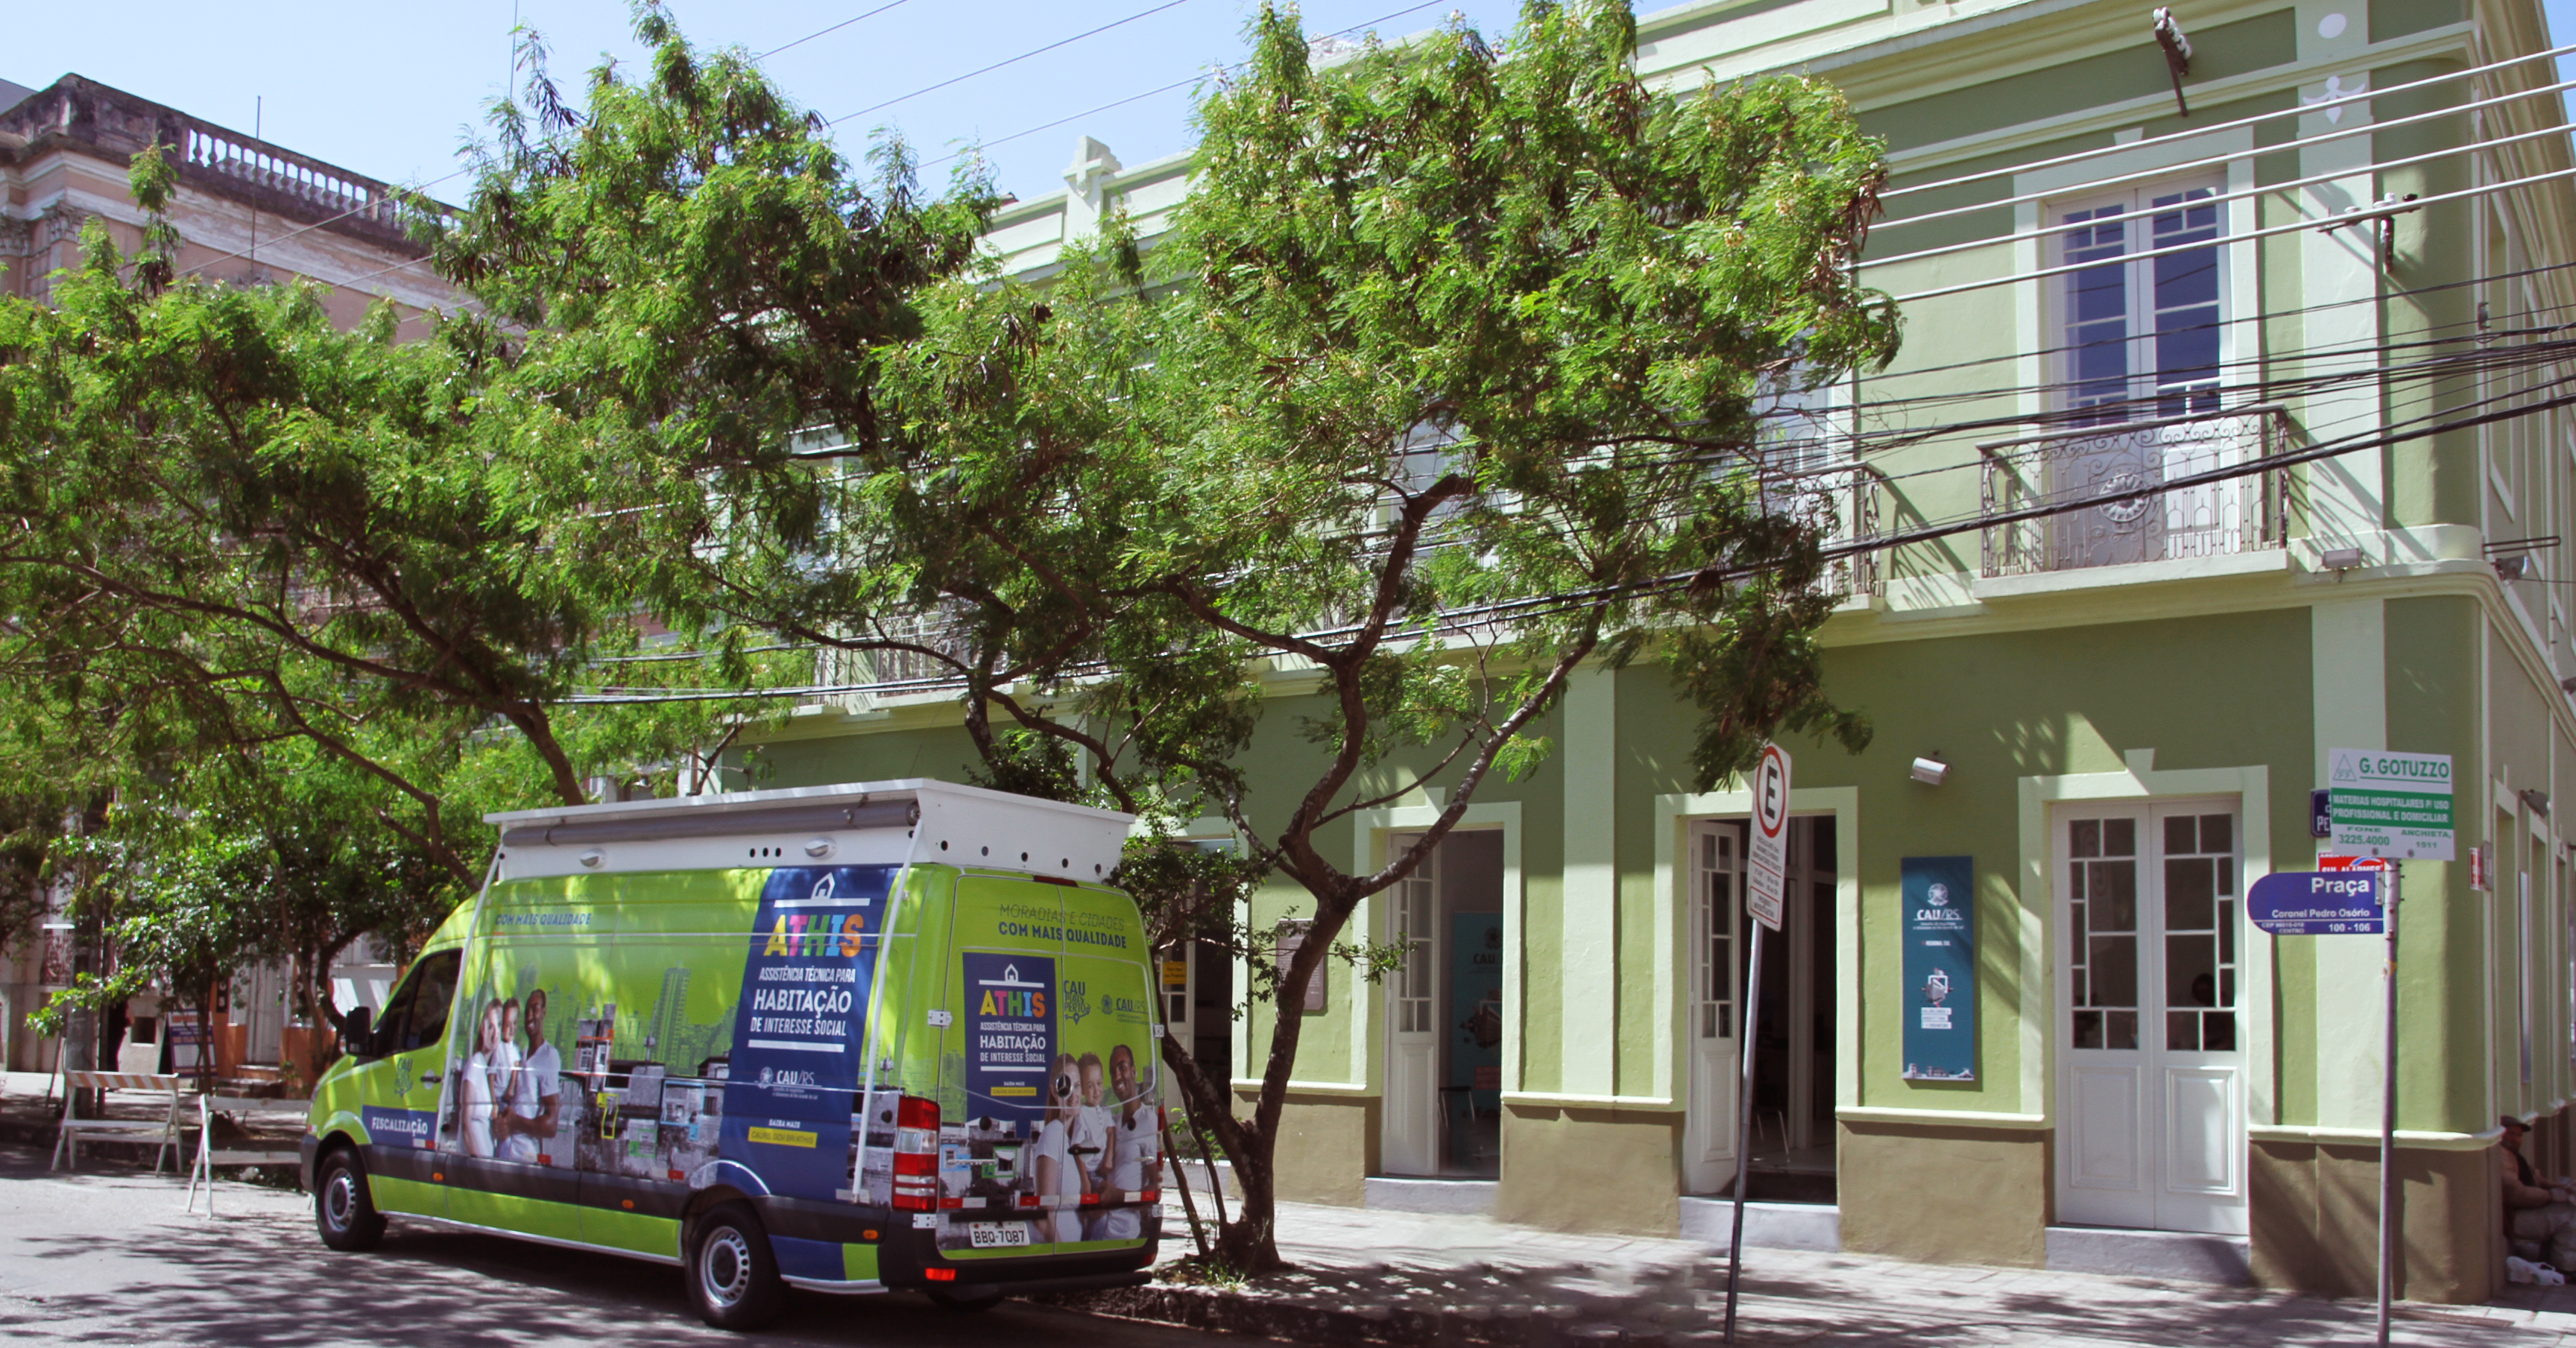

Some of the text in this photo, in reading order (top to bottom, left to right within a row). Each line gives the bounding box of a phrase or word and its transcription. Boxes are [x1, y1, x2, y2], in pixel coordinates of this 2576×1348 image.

[2359, 757, 2375, 774] G.
[2378, 759, 2450, 779] GOTUZZO
[1764, 765, 1778, 820] E
[2371, 797, 2425, 809] HOSPITALARES
[2434, 800, 2450, 810] USO
[2332, 808, 2393, 820] PROFISSIONAL
[2393, 811, 2399, 820] E
[2401, 811, 2449, 823] DOMICILIAR
[2311, 877, 2370, 897] Praça
[496, 913, 592, 925] COM MAIS QUALIDADE
[1000, 904, 1125, 931] MORADIAS E CIDADES
[2271, 907, 2370, 919] Coronel Pedro Osório
[763, 914, 865, 958] ATHIS
[998, 921, 1127, 949] COM MAIS QUALIDADE
[2329, 923, 2345, 932] 100
[2353, 923, 2370, 932] 106
[759, 965, 856, 983] ASSISTÊNCIA TÉCNICA PARA
[1064, 980, 1086, 996] CAU
[753, 985, 852, 1019] HABITAÇÃO
[979, 990, 1046, 1018] ATHIS
[751, 1016, 847, 1037] DE INTERESSE SOCIAL
[1033, 1024, 1046, 1032] PARA
[979, 1034, 1046, 1053] HABITAÇÃO
[979, 1052, 1046, 1063] DE INTERESSE SOCIAL
[372, 1117, 429, 1137] FISCALIZAÇÃO
